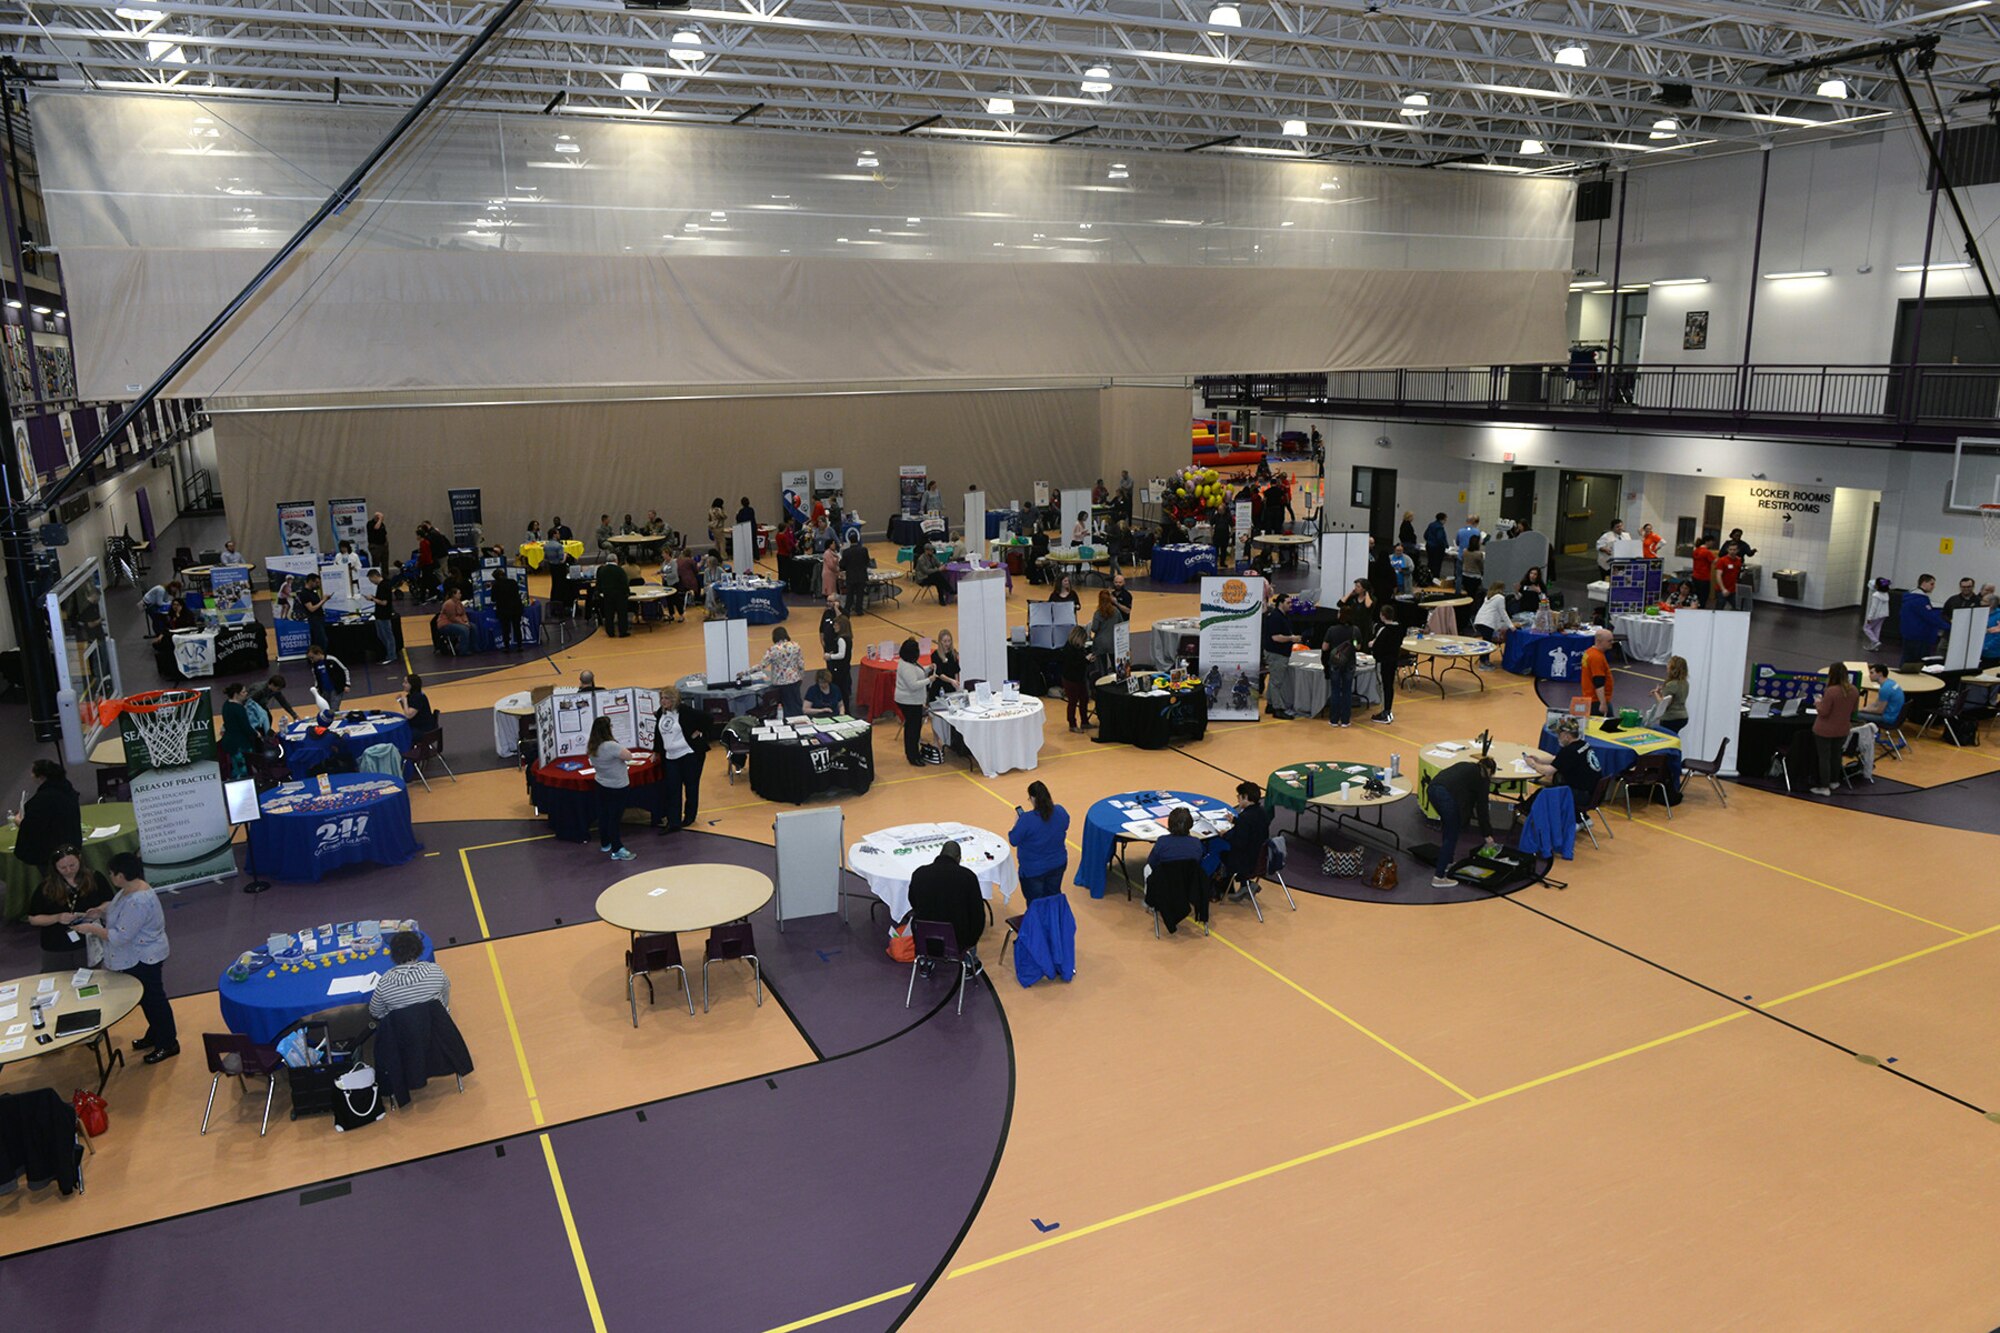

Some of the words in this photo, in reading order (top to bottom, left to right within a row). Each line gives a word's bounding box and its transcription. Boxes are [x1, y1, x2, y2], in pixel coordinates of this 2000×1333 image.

[1750, 488, 1790, 499] LOCKER
[1793, 491, 1831, 503] ROOMS
[1758, 499, 1820, 514] RESTROOMS
[134, 783, 161, 794] AREAS
[162, 780, 174, 789] OF
[176, 773, 217, 786] PRACTICE
